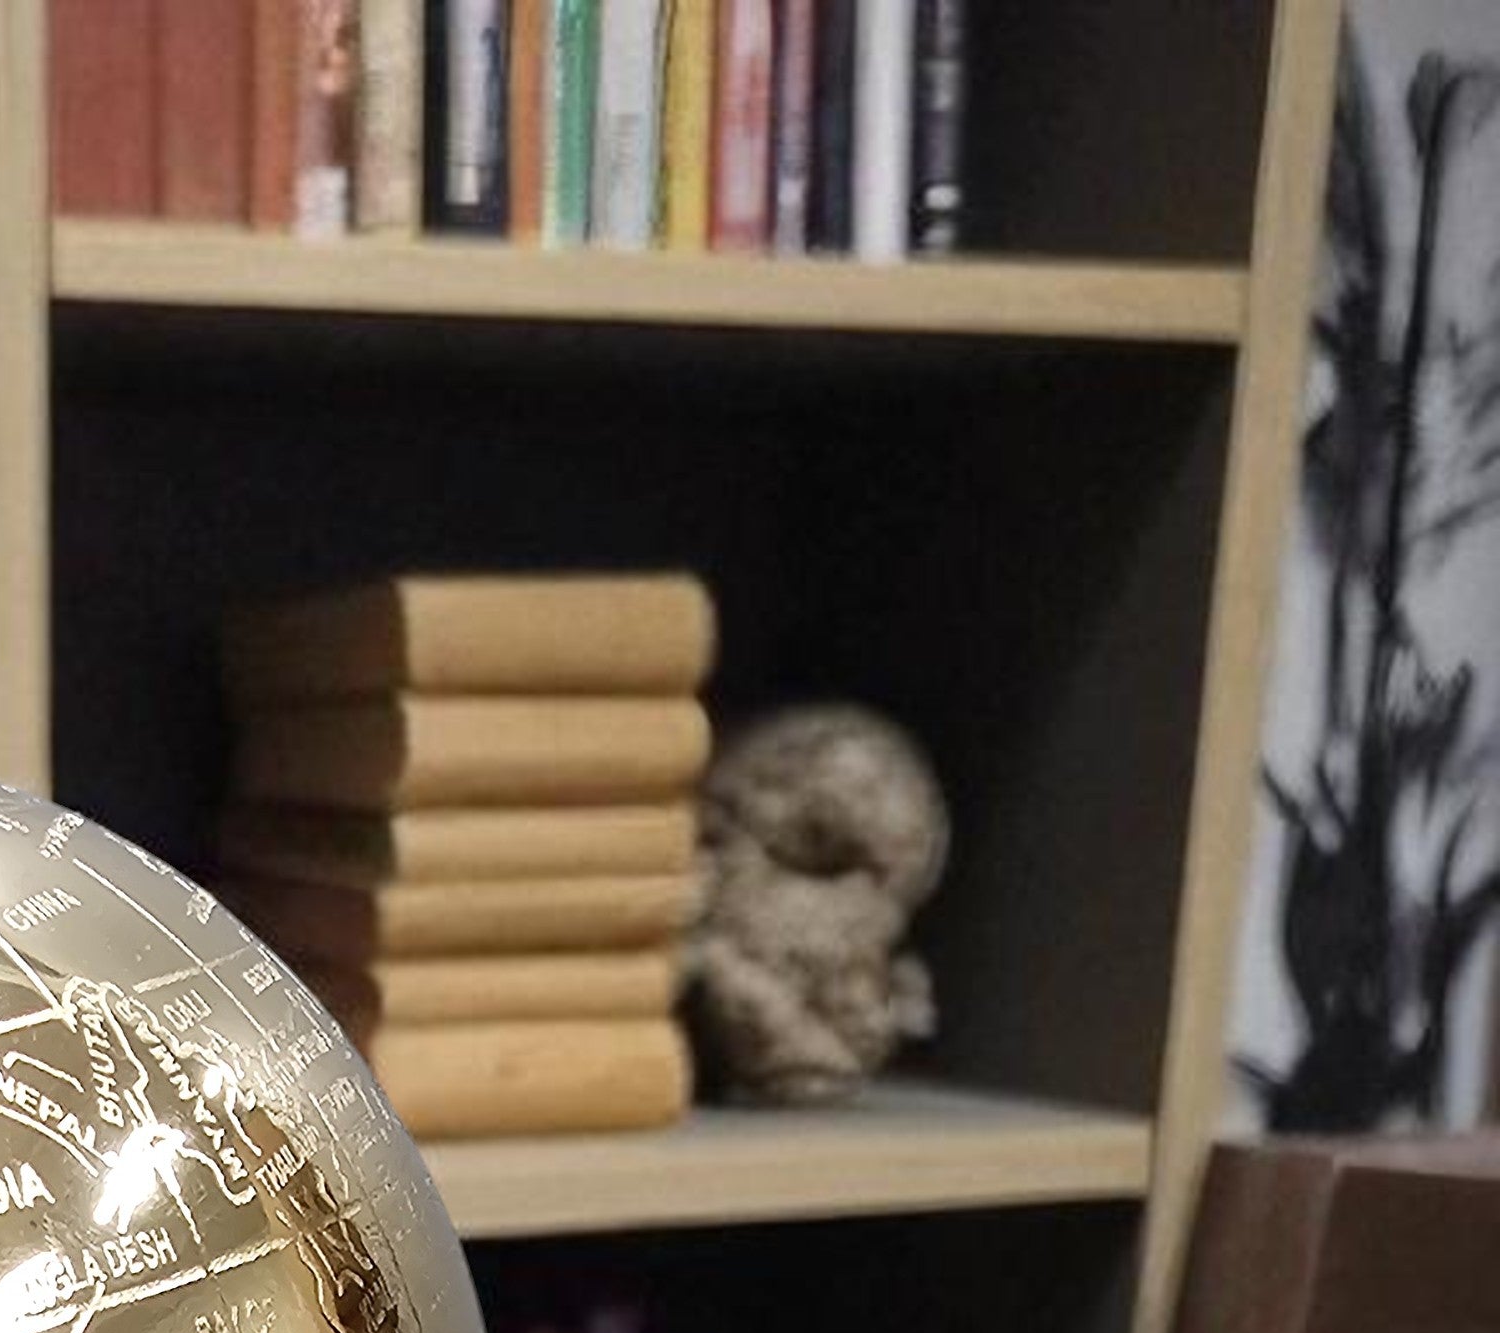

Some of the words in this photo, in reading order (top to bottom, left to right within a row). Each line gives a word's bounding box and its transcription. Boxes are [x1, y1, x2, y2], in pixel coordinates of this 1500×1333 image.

[3, 888, 82, 930] CHINA
[92, 988, 124, 1128] BHUTAN
[116, 996, 249, 1181] MYANMAR
